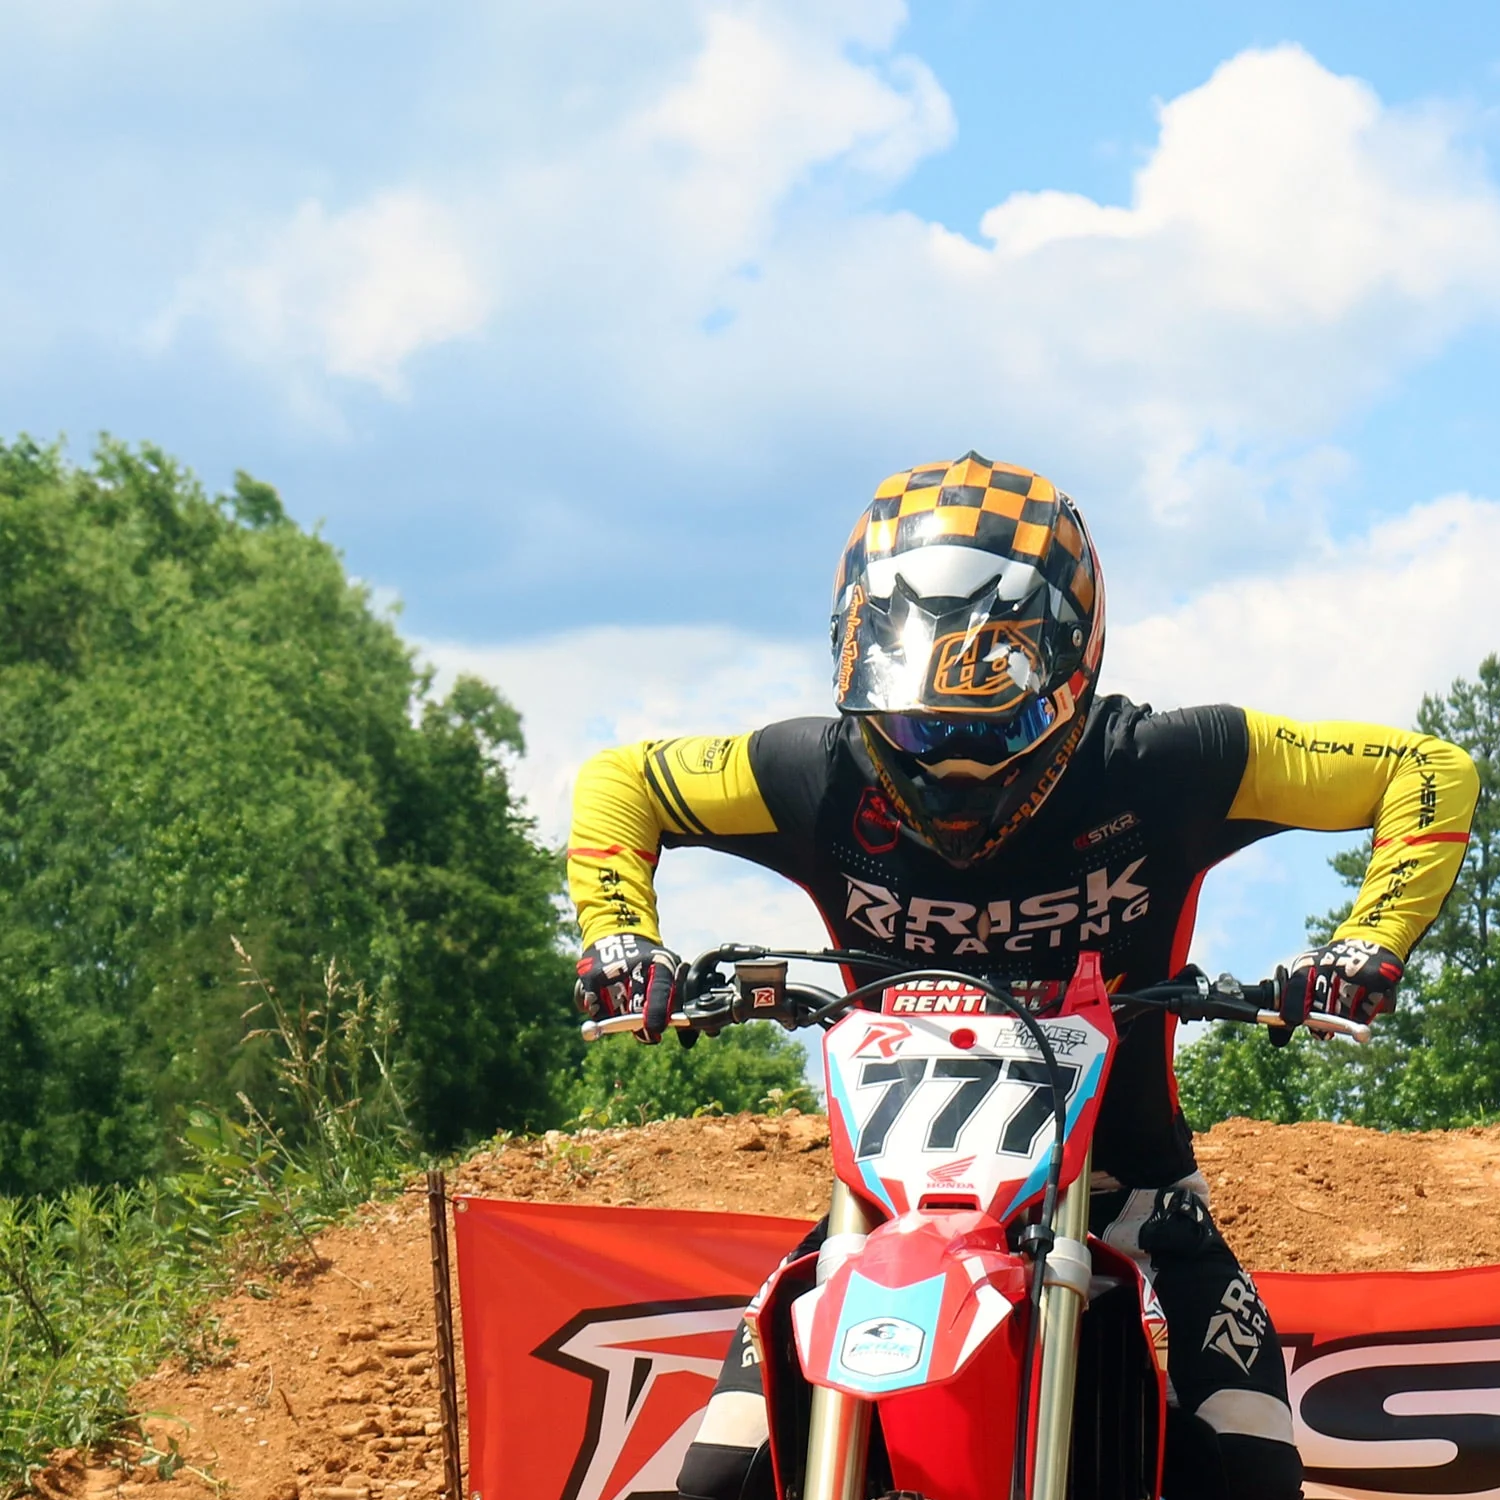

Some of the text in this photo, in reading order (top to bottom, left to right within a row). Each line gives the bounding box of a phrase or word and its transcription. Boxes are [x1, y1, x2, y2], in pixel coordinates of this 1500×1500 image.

[1087, 814, 1135, 845] STKR
[904, 893, 1150, 955] RACING
[905, 855, 1149, 935] RISK
[855, 1056, 1082, 1163] 777
[926, 1181, 975, 1190] HONDA
